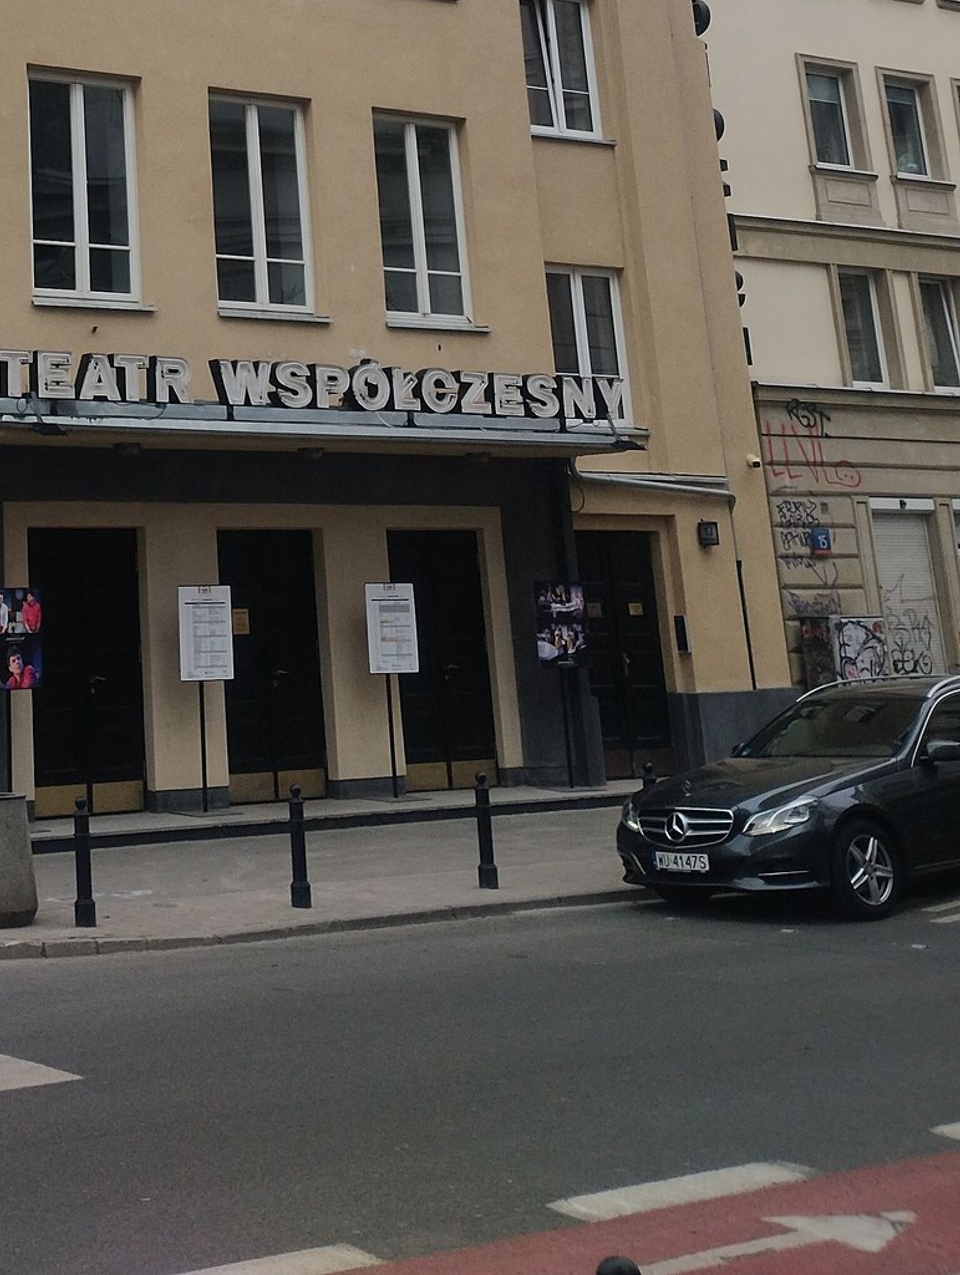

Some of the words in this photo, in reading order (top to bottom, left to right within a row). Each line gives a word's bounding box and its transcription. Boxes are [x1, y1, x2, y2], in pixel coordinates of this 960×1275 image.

[209, 358, 625, 420] WSPÓŁCZESNY
[817, 535, 828, 549] 15
[673, 854, 707, 869] 4147S
